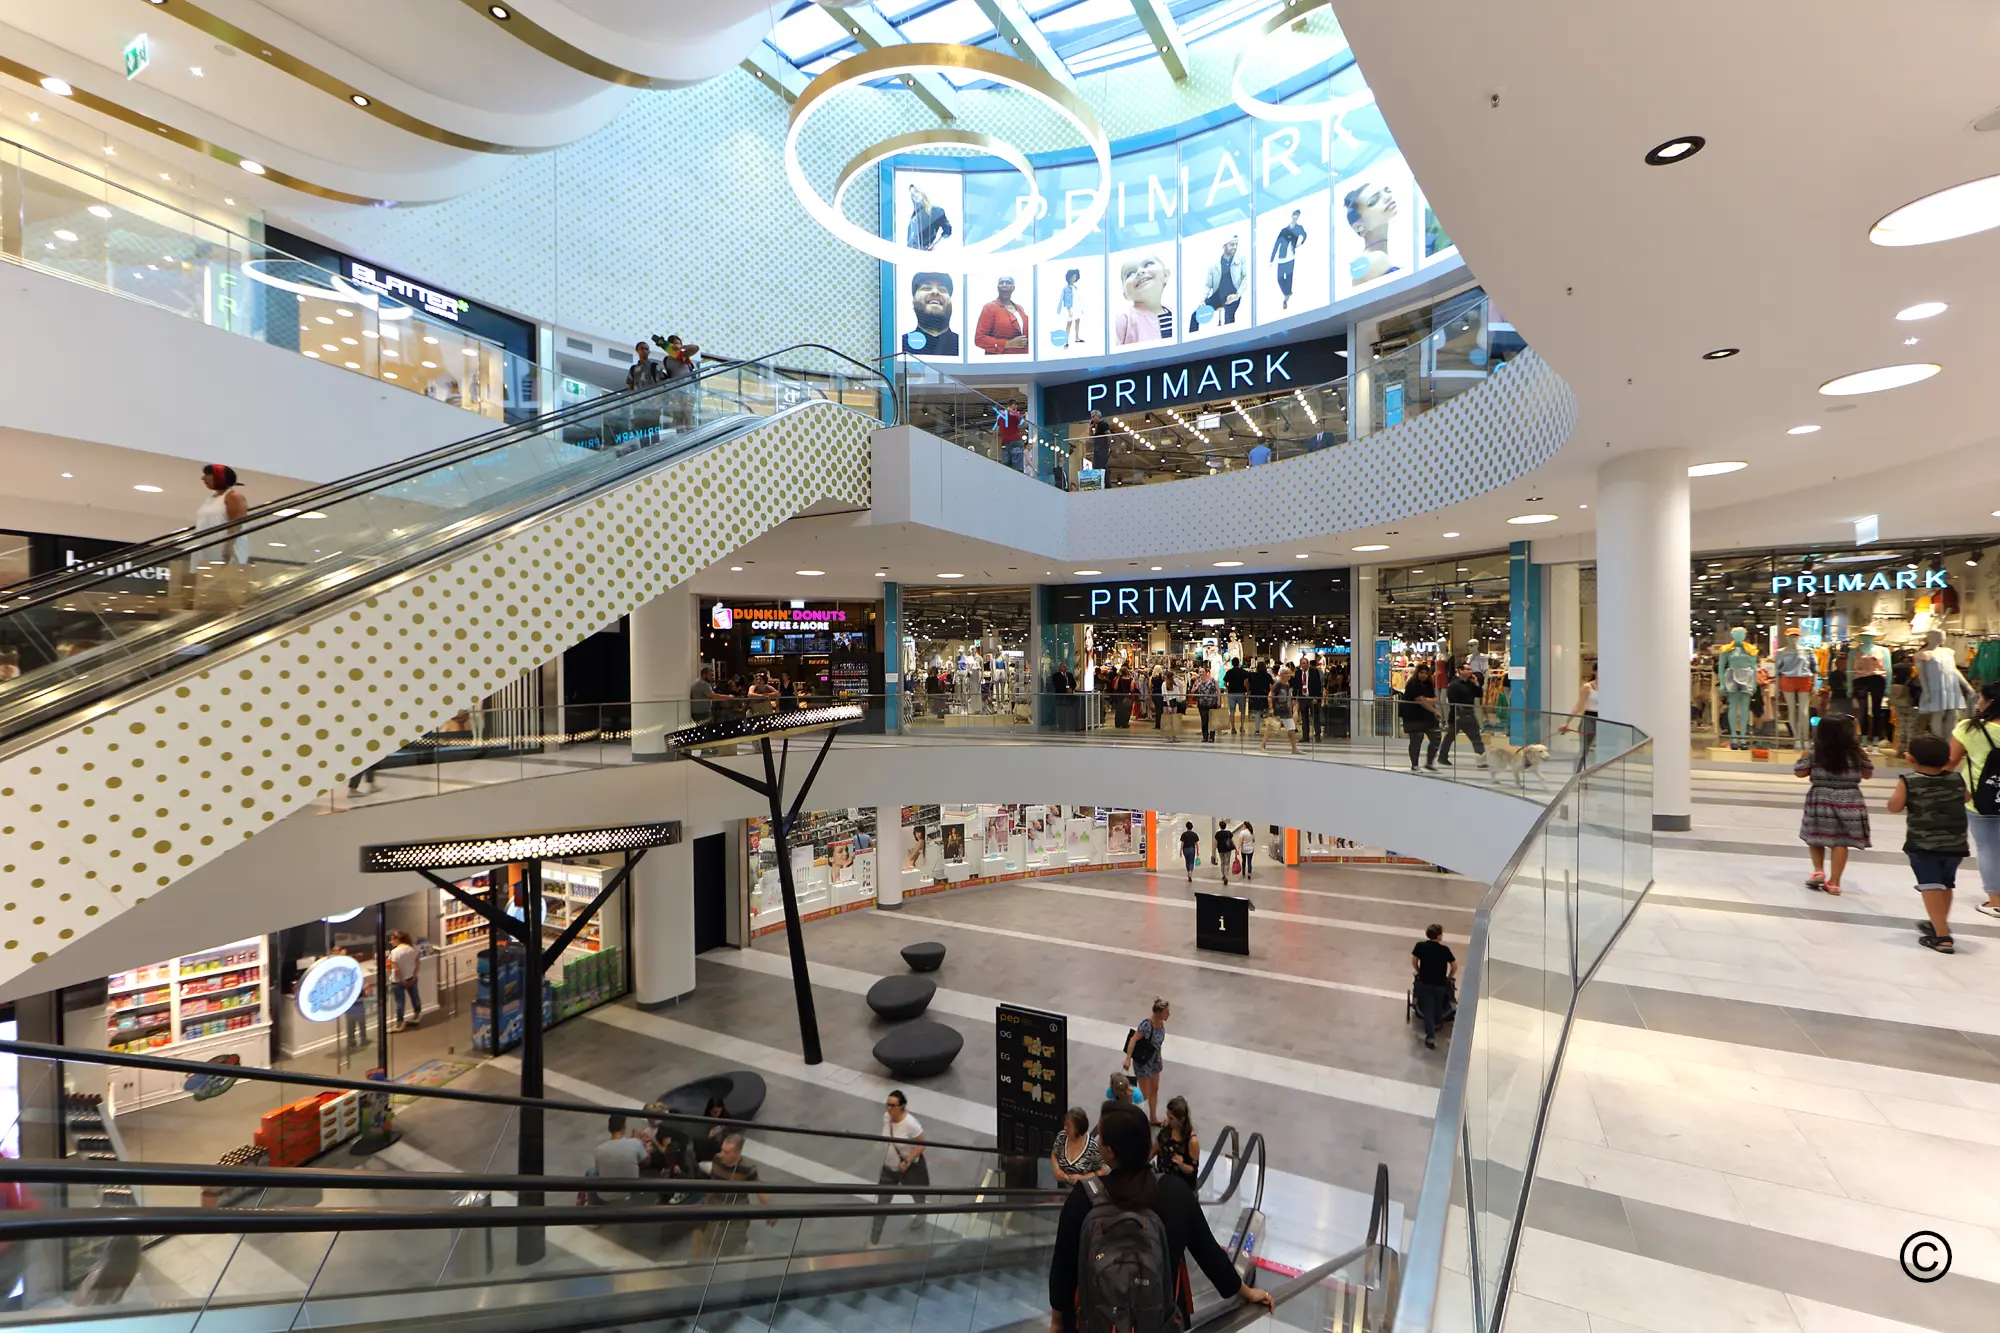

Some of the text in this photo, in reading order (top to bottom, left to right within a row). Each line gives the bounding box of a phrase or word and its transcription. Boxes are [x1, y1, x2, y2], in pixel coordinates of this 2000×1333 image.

[1087, 351, 1291, 412] PRIMARK
[1771, 569, 1948, 594] PRIMARK
[1091, 579, 1294, 616] PRIMARK
[733, 608, 846, 622] DUNKIN' DONUTS
[751, 621, 829, 631] COFFEE & MORE
[1000, 1013, 1020, 1024] pep
[1000, 1030, 1012, 1039] OG
[1000, 1052, 1011, 1061] EG
[1000, 1074, 1012, 1084] UG
